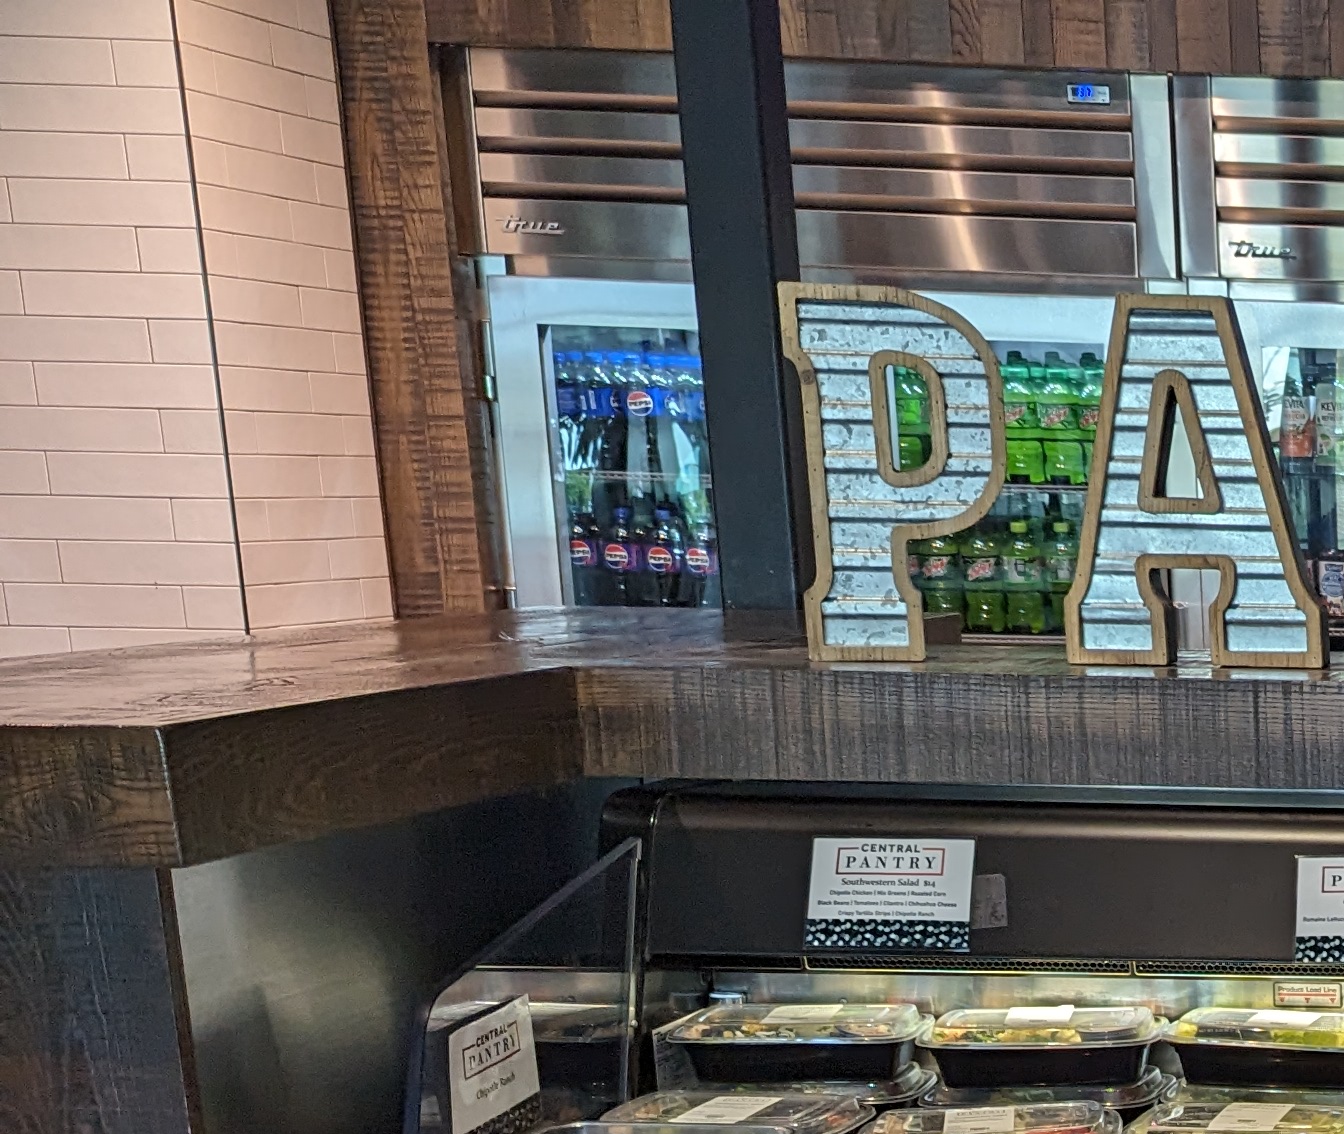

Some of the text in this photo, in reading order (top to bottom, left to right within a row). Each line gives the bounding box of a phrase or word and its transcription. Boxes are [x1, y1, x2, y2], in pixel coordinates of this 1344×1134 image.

[861, 843, 921, 853] CENTRAL
[845, 855, 937, 870] PANTRY
[841, 878, 896, 886] Southwestern
[897, 879, 920, 887] Salad
[475, 1023, 508, 1048] CENTRAL
[468, 1034, 516, 1071] PANTRY
